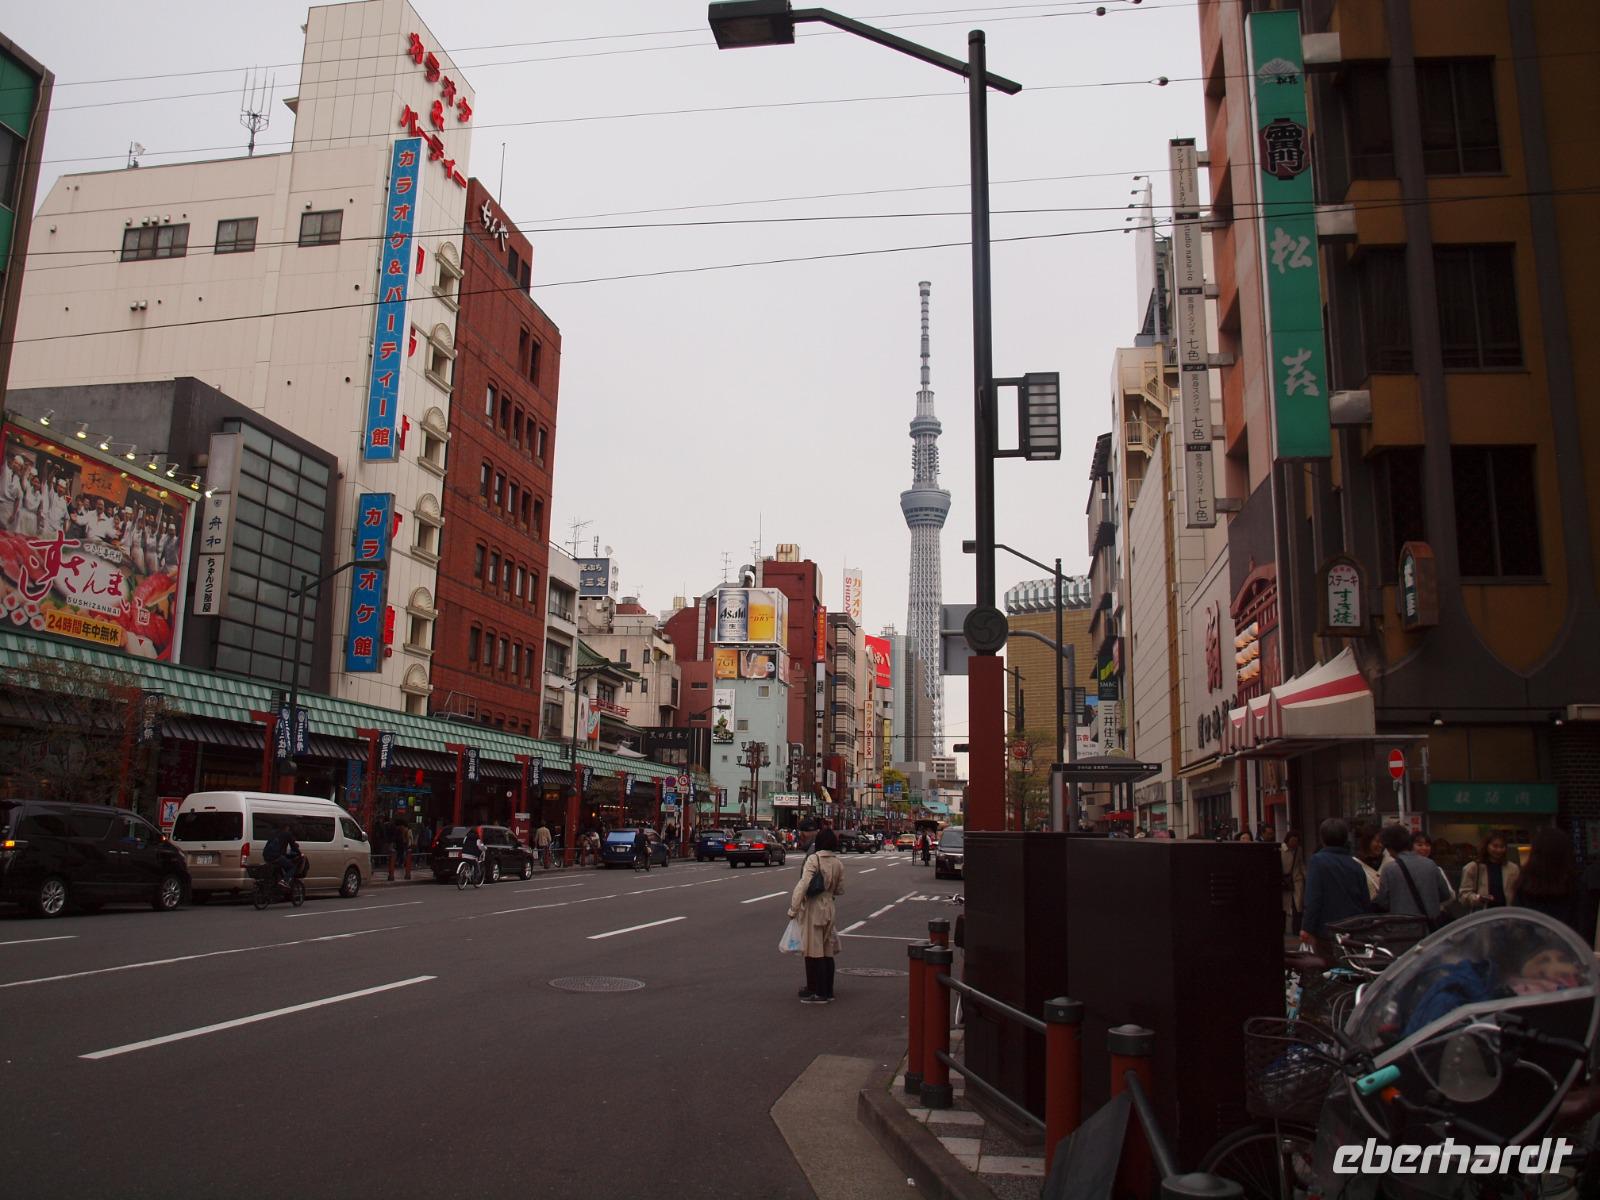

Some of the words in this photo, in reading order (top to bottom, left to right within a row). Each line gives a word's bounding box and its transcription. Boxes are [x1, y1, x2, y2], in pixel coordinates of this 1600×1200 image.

[205, 516, 222, 548] 舟和
[353, 507, 383, 657] カラオケ館
[1328, 575, 1358, 586] ステーキ
[47, 613, 119, 641] 24時間年中無休
[719, 607, 746, 619] Asahi
